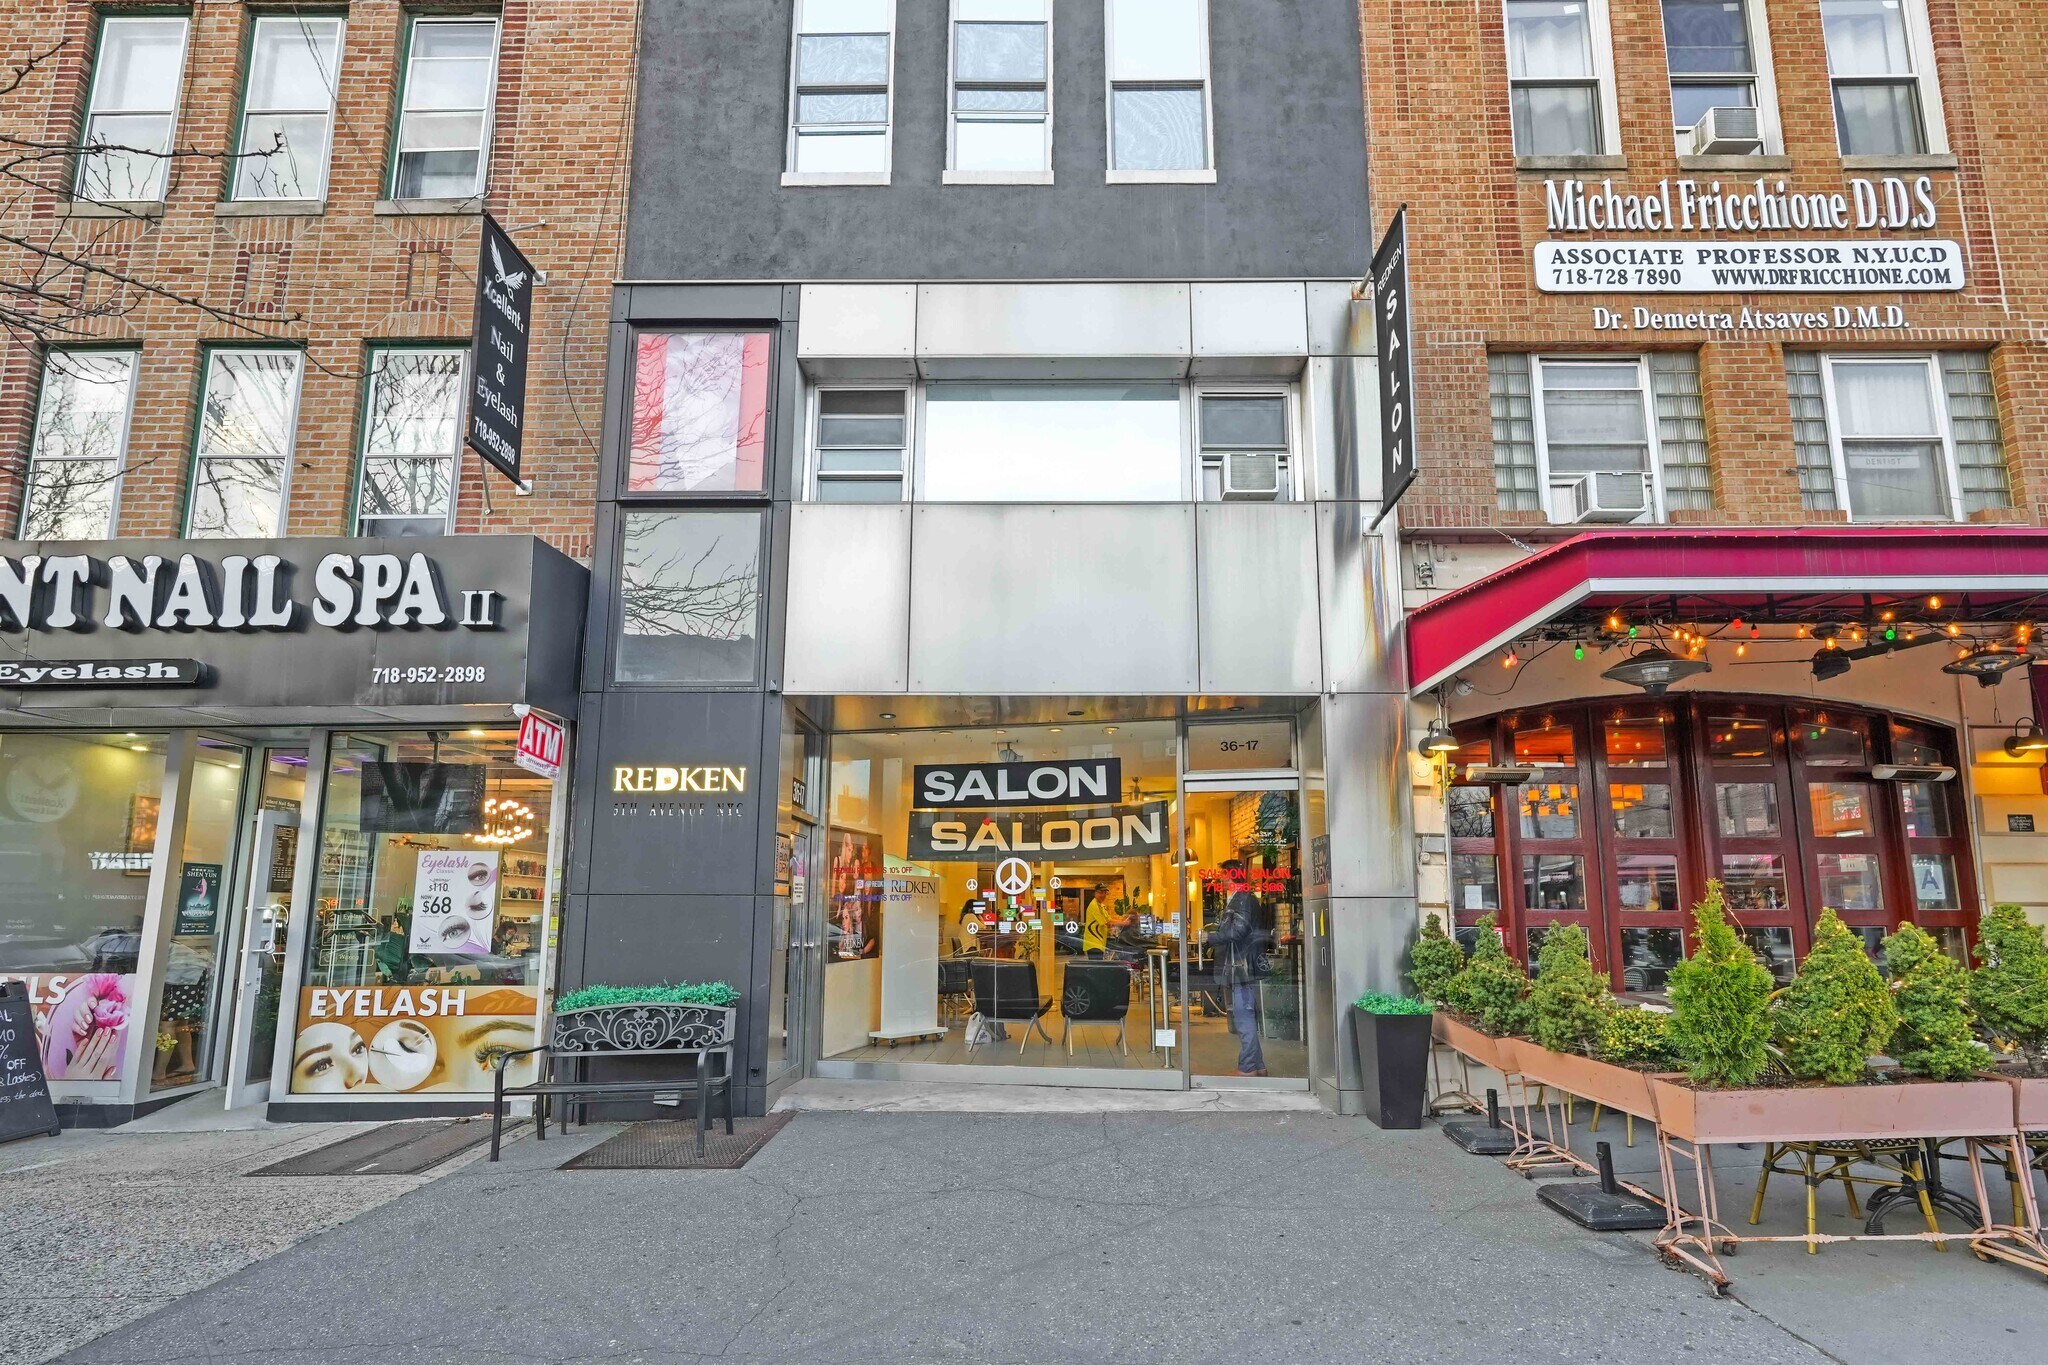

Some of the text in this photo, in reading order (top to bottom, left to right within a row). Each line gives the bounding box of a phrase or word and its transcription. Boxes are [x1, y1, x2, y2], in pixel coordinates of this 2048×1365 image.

[1543, 176, 1937, 232] Michael Fricchione D.D.S
[1551, 246, 1948, 265] ASSOCIATE PROFESSOR N.Y.U.C.D
[1377, 242, 1402, 296] REDKEN
[1711, 267, 1952, 286] WWW.DRFRICCHIONE.COM
[483, 275, 521, 331] Xcellent
[1592, 305, 1910, 330] Dr. Demetra Atsaves D.M.D.
[489, 325, 514, 364] Nail
[495, 363, 506, 386] &
[1385, 288, 1403, 474] SALON
[476, 374, 518, 428] Eyelash
[474, 415, 516, 465] 718-952-2898
[104, 553, 293, 628] NAIL
[312, 552, 446, 627] SPA
[458, 590, 496, 625] II
[372, 666, 486, 684] 718-952-2898
[521, 715, 561, 763] ATM
[1220, 740, 1259, 752] 36-17
[612, 767, 747, 792] REDKEN
[923, 765, 1108, 803] SALON
[648, 802, 705, 817] AVENUE
[930, 812, 1162, 852] SALOON
[421, 854, 469, 875] Eyelash
[1250, 867, 1292, 880] SALON
[891, 880, 936, 894] REDKEN
[1921, 868, 1940, 890] A
[422, 896, 452, 915] $68
[310, 988, 468, 1018] EYELASH
[6, 1058, 27, 1071] OFF
